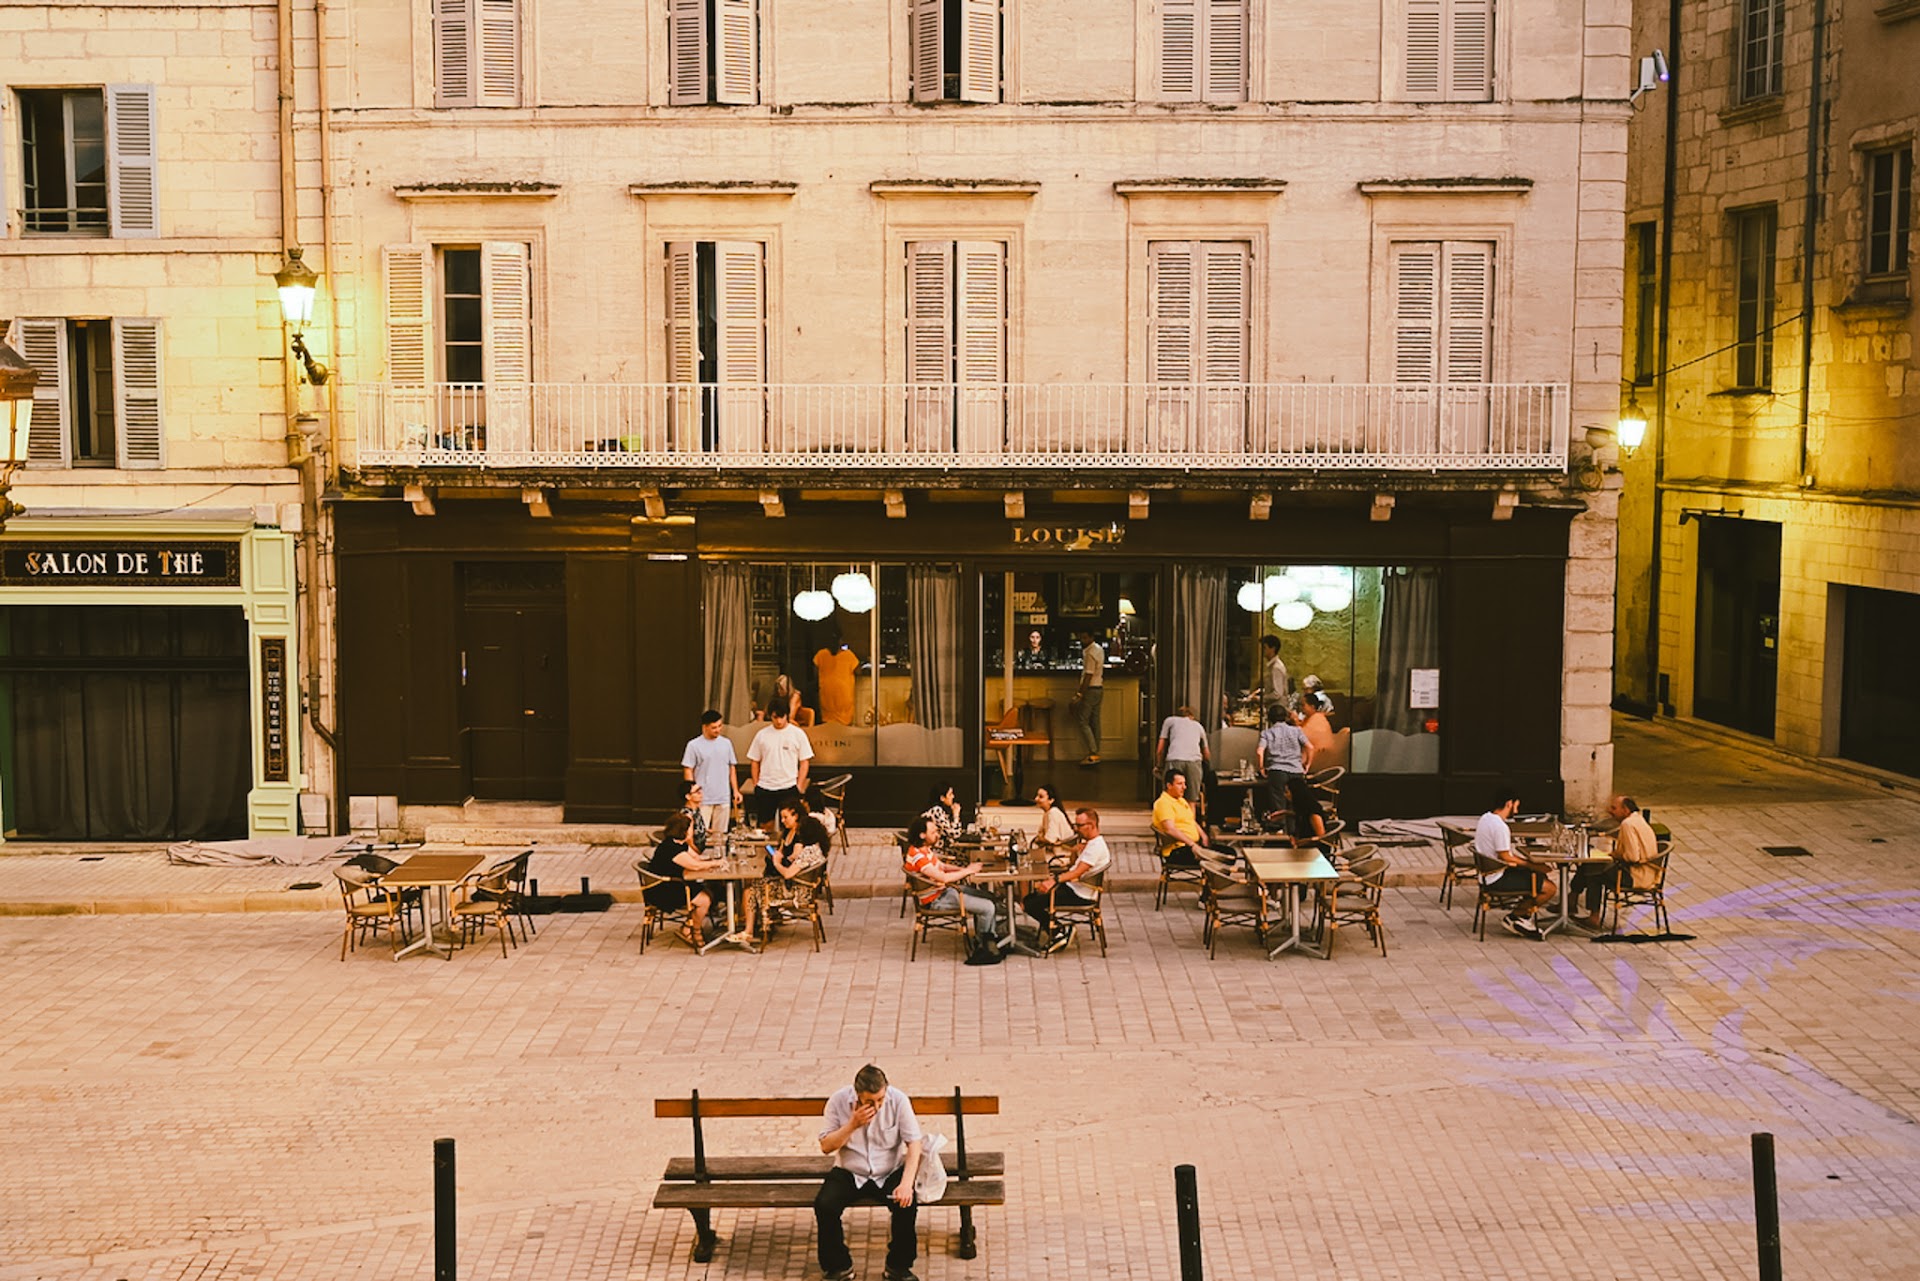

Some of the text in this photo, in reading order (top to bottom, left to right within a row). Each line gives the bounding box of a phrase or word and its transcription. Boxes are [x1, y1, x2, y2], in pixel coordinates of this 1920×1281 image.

[1013, 527, 1122, 543] LOUISE
[25, 552, 107, 575] SALON
[116, 553, 148, 574] DE
